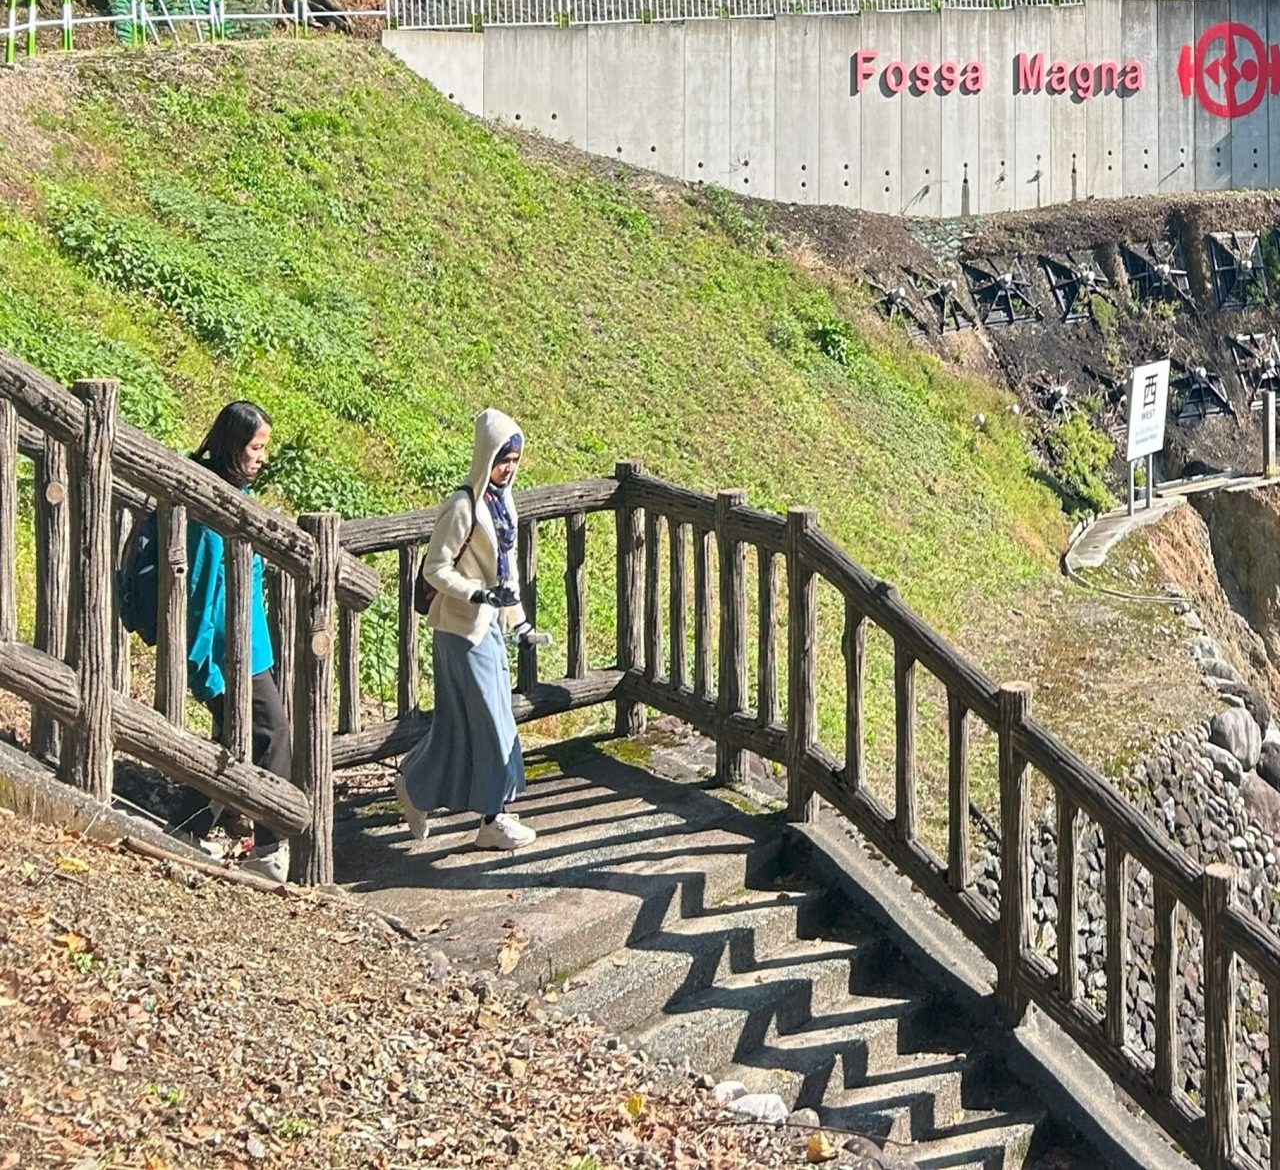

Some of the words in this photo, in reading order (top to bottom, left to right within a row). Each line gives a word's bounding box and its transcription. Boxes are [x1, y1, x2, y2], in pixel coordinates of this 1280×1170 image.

[853, 49, 985, 95] Fossa
[1016, 50, 1143, 98] Magna
[1143, 373, 1158, 409] 西
[1141, 409, 1156, 421] WEST
